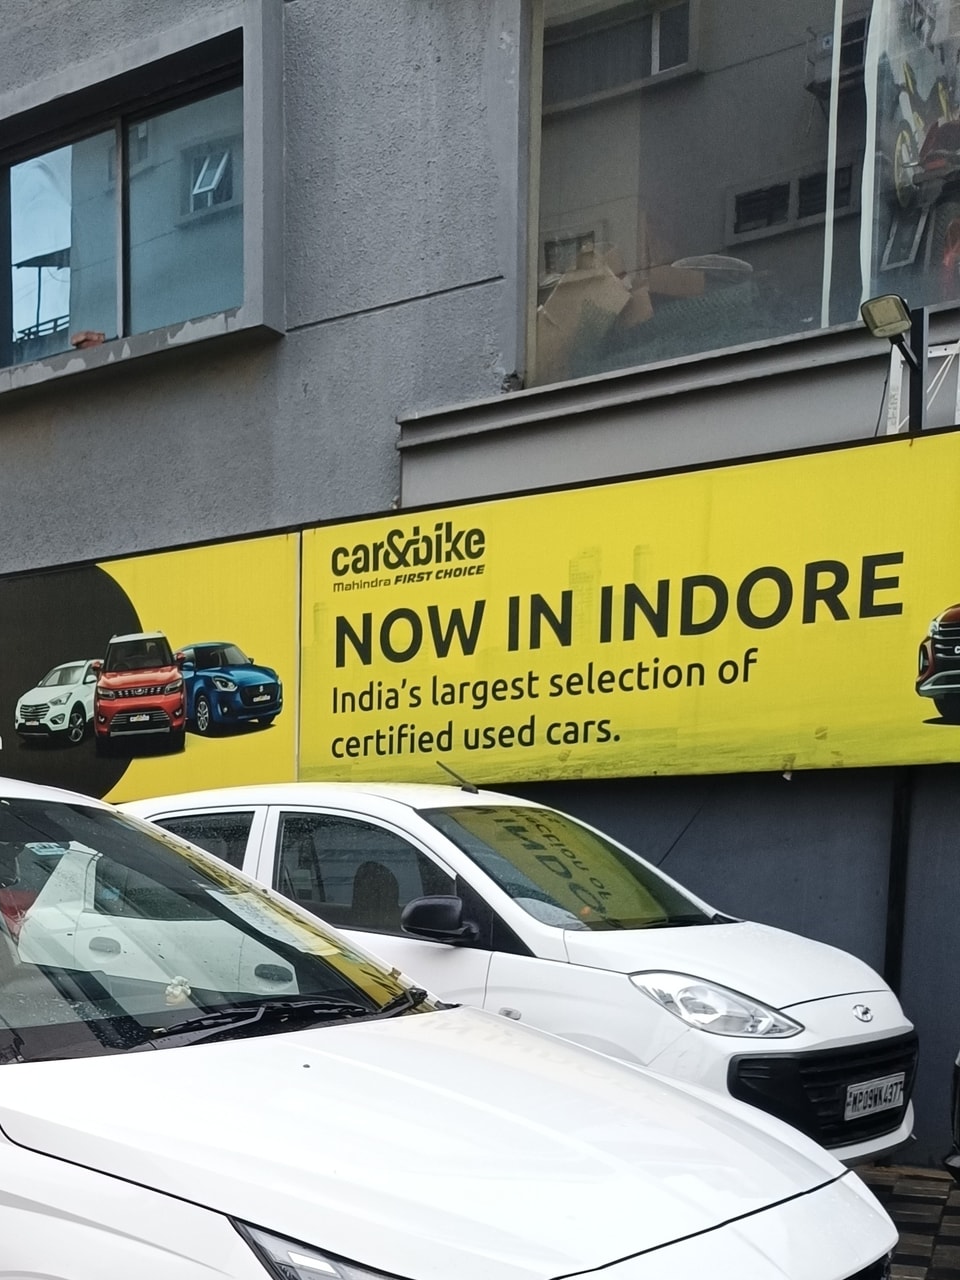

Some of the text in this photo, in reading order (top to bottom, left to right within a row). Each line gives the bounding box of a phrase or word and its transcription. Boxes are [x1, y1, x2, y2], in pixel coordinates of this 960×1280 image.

[331, 521, 486, 577] car&bike
[333, 564, 486, 593] Mahindra FIRST CHOICE
[335, 551, 905, 669] NOW IN INDORE
[331, 648, 759, 714] India's largest selection of
[330, 715, 621, 759] certified used cars.
